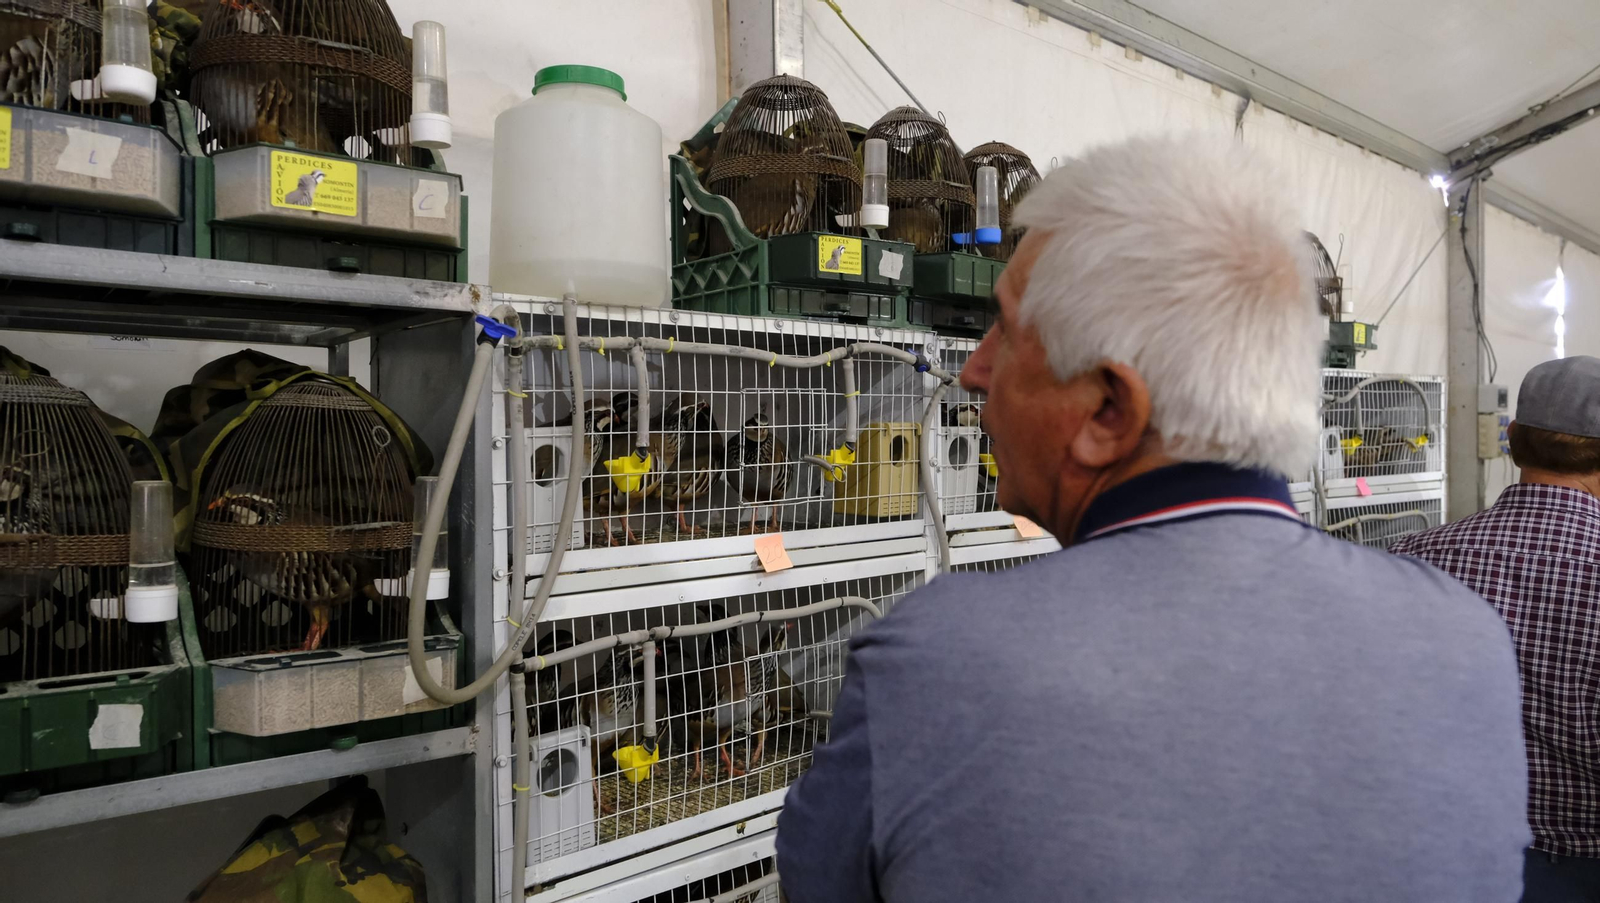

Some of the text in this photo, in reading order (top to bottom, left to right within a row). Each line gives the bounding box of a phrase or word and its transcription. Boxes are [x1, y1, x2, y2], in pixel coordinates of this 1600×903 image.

[277, 155, 333, 170] PERDICES
[821, 237, 849, 245] PERDICES
[762, 542, 783, 564] 20
